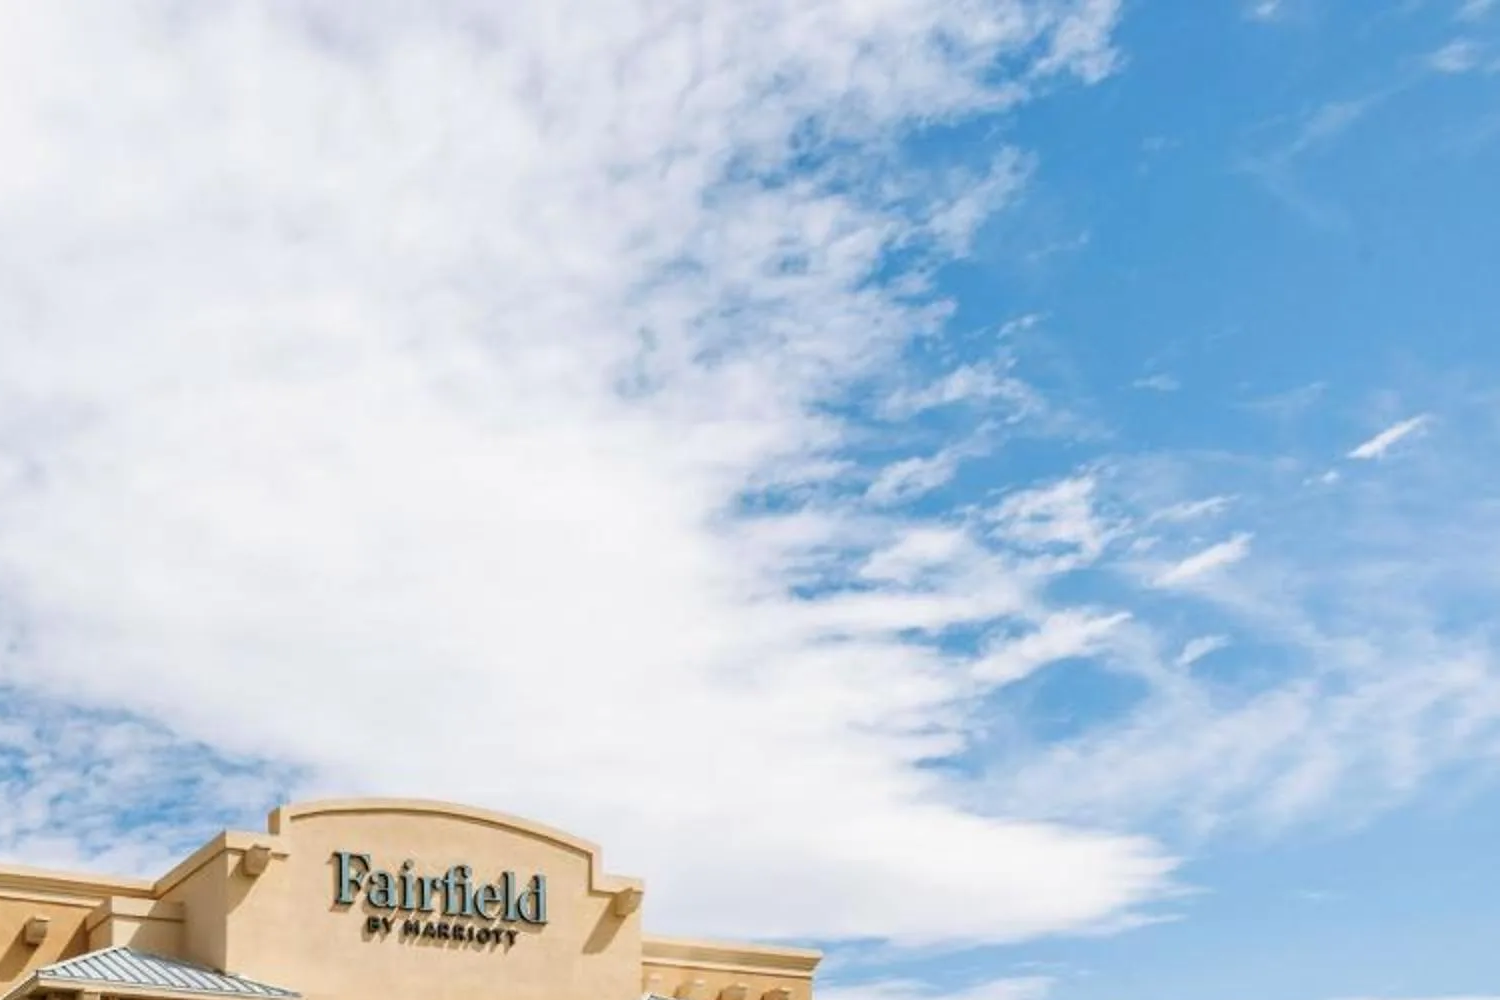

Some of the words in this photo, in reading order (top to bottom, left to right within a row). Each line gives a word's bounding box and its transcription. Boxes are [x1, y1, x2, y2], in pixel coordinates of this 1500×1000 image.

[332, 851, 548, 924] Fairfield
[366, 915, 393, 934] BY
[403, 918, 519, 946] MARRIOTT
